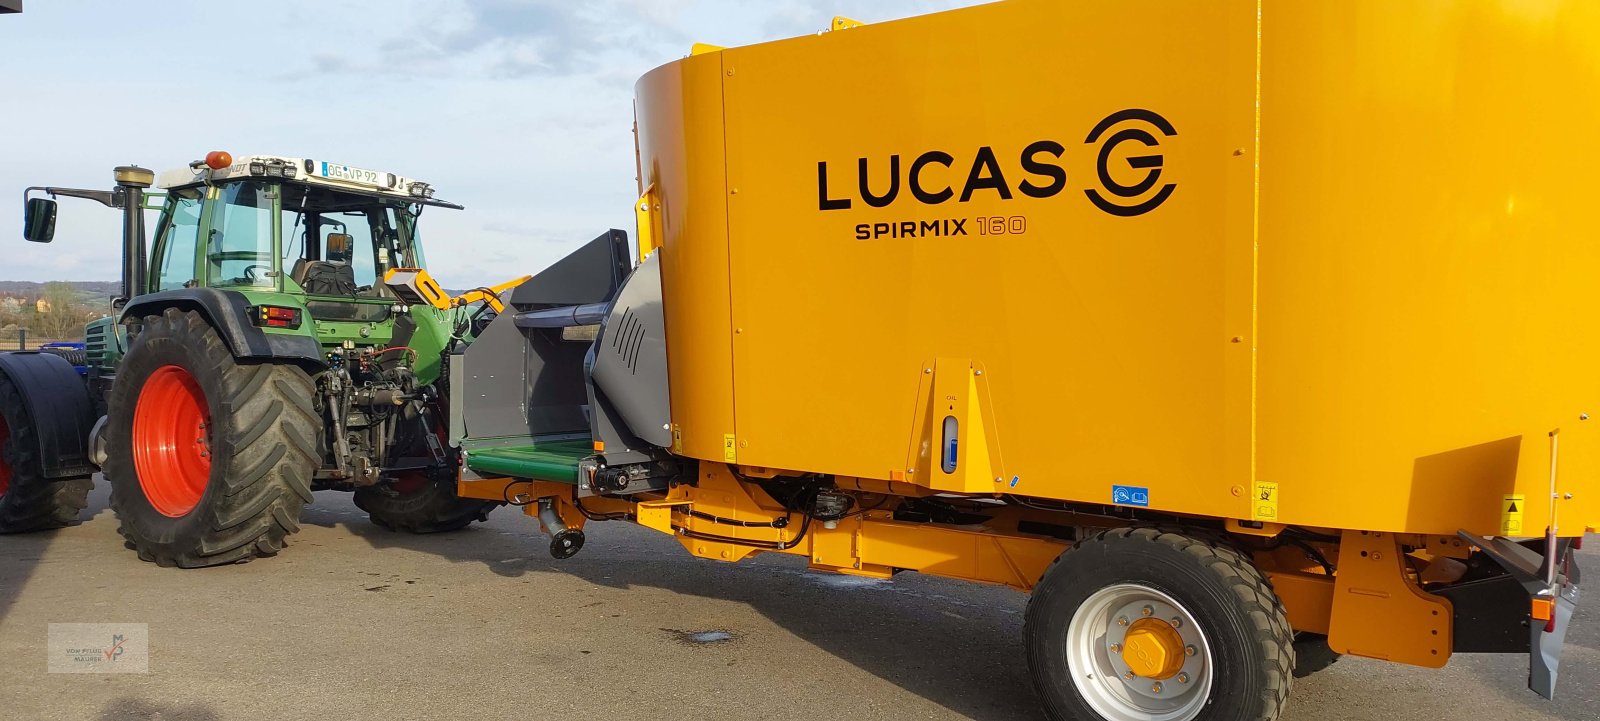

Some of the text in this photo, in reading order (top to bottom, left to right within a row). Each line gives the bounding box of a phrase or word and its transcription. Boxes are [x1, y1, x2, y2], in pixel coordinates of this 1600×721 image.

[328, 164, 378, 183] OG VP 92
[818, 140, 1067, 211] LUCAS
[855, 215, 1027, 240] SPIRMIX 160
